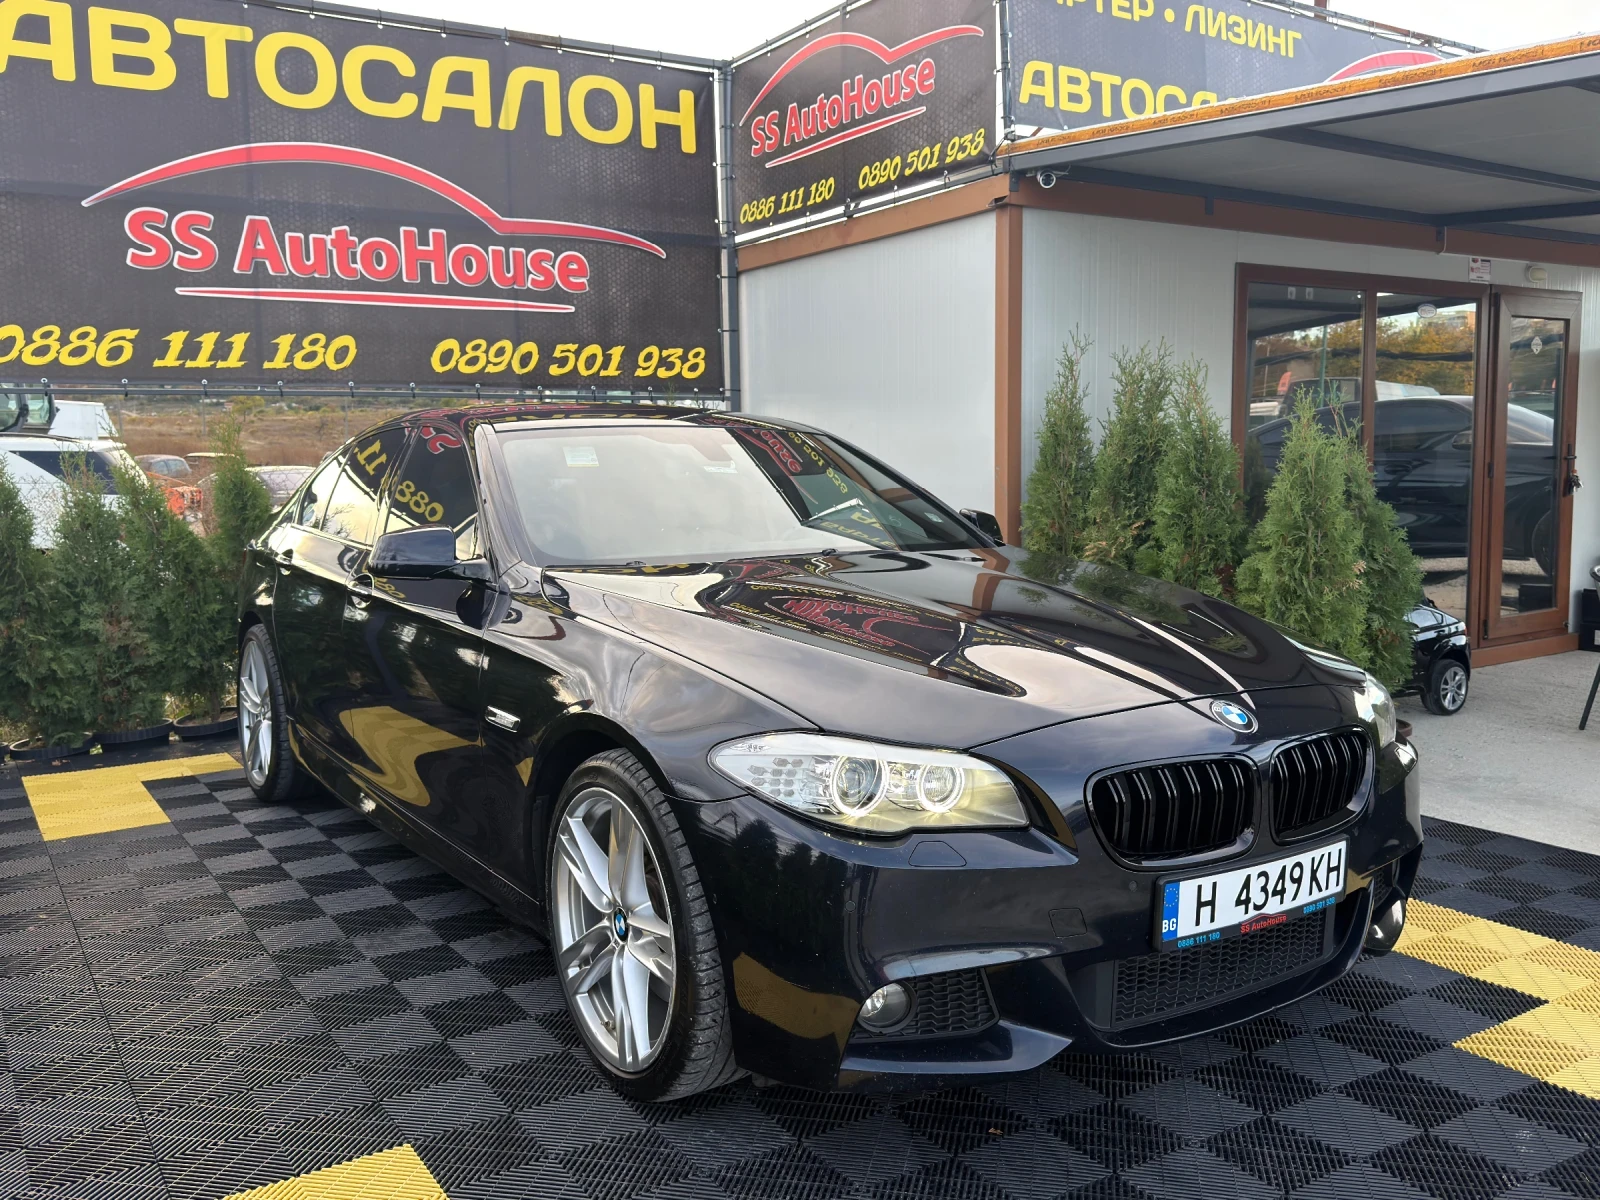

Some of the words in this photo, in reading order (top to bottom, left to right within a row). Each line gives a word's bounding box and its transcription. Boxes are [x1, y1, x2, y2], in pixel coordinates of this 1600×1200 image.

[1185, 4, 1302, 58] ЛИЗИНГ
[0, 0, 697, 154] АВТОСАЛОН
[751, 109, 780, 157] SS
[783, 58, 936, 146] AutoHouse
[859, 156, 902, 190] 0890
[904, 143, 941, 177] 501
[945, 128, 986, 163] 938
[739, 195, 776, 224] 0886
[777, 187, 805, 214] 111
[807, 177, 836, 206] 180
[124, 206, 219, 273] SS
[234, 214, 590, 293] AutoHouse
[0, 324, 140, 368] 0886
[152, 331, 250, 369] 111
[262, 333, 358, 371] 180
[430, 338, 540, 375] 0890
[548, 343, 626, 377] 501
[634, 345, 707, 380] 938
[1234, 861, 1304, 915] 4349
[1161, 918, 1178, 933] BG
[1196, 933, 1208, 945] 111
[1240, 924, 1251, 934] SS
[1251, 915, 1288, 931] AutoHouse
